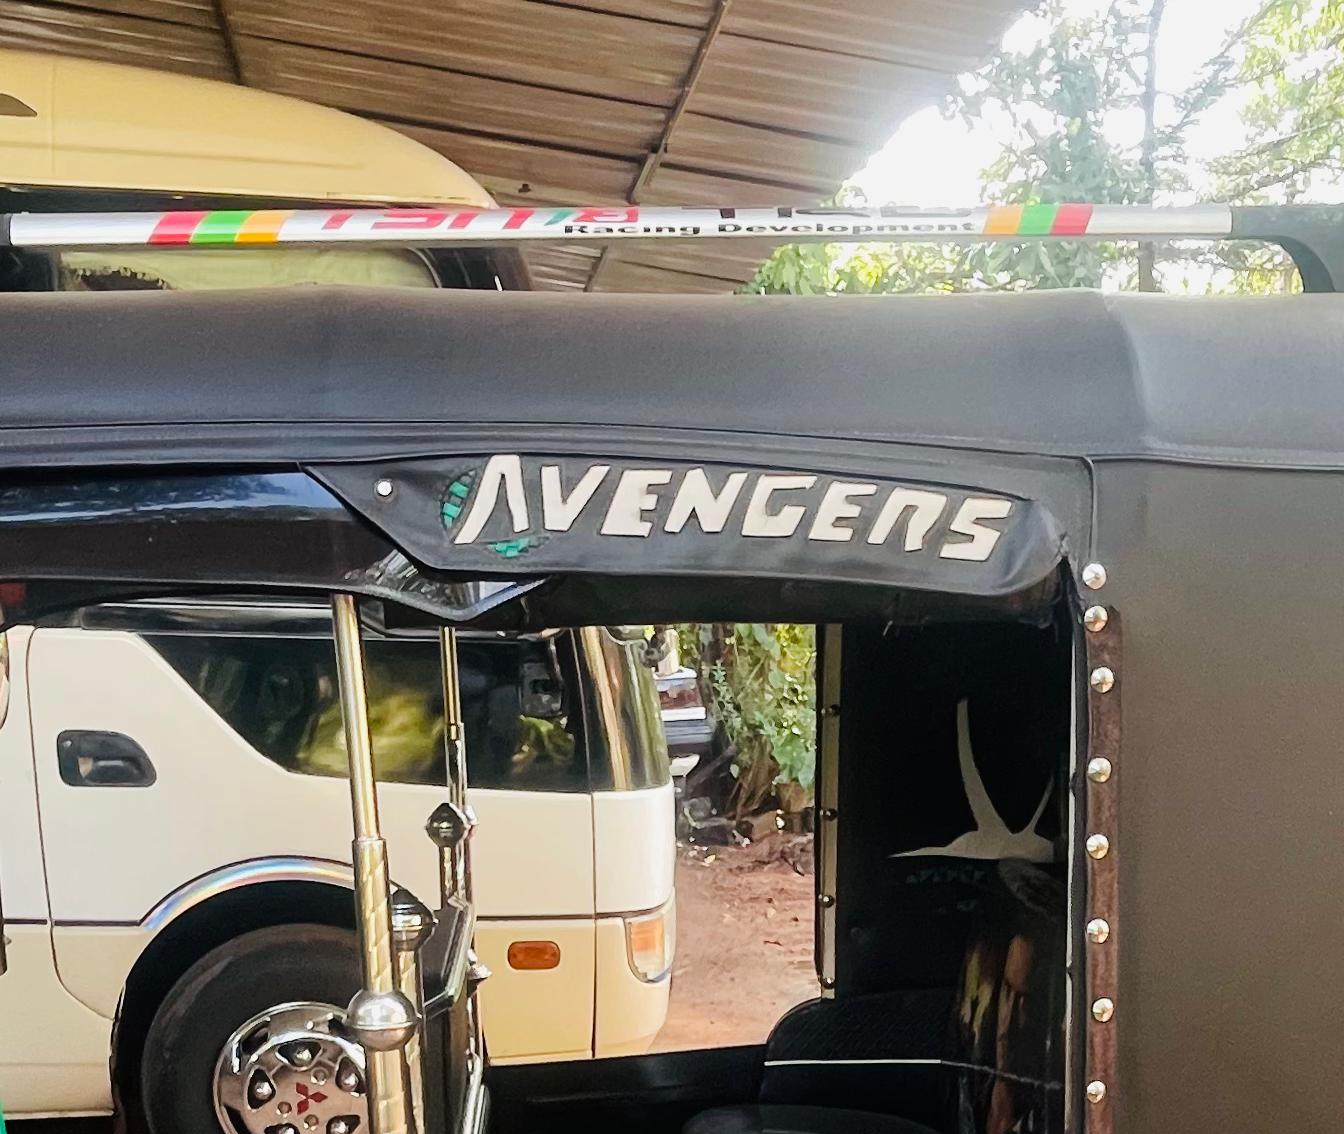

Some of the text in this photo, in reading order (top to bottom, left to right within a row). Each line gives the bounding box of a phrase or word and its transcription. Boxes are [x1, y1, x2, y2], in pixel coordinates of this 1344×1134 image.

[564, 221, 976, 236] Racing Development
[455, 453, 1013, 562] AVENGERS
